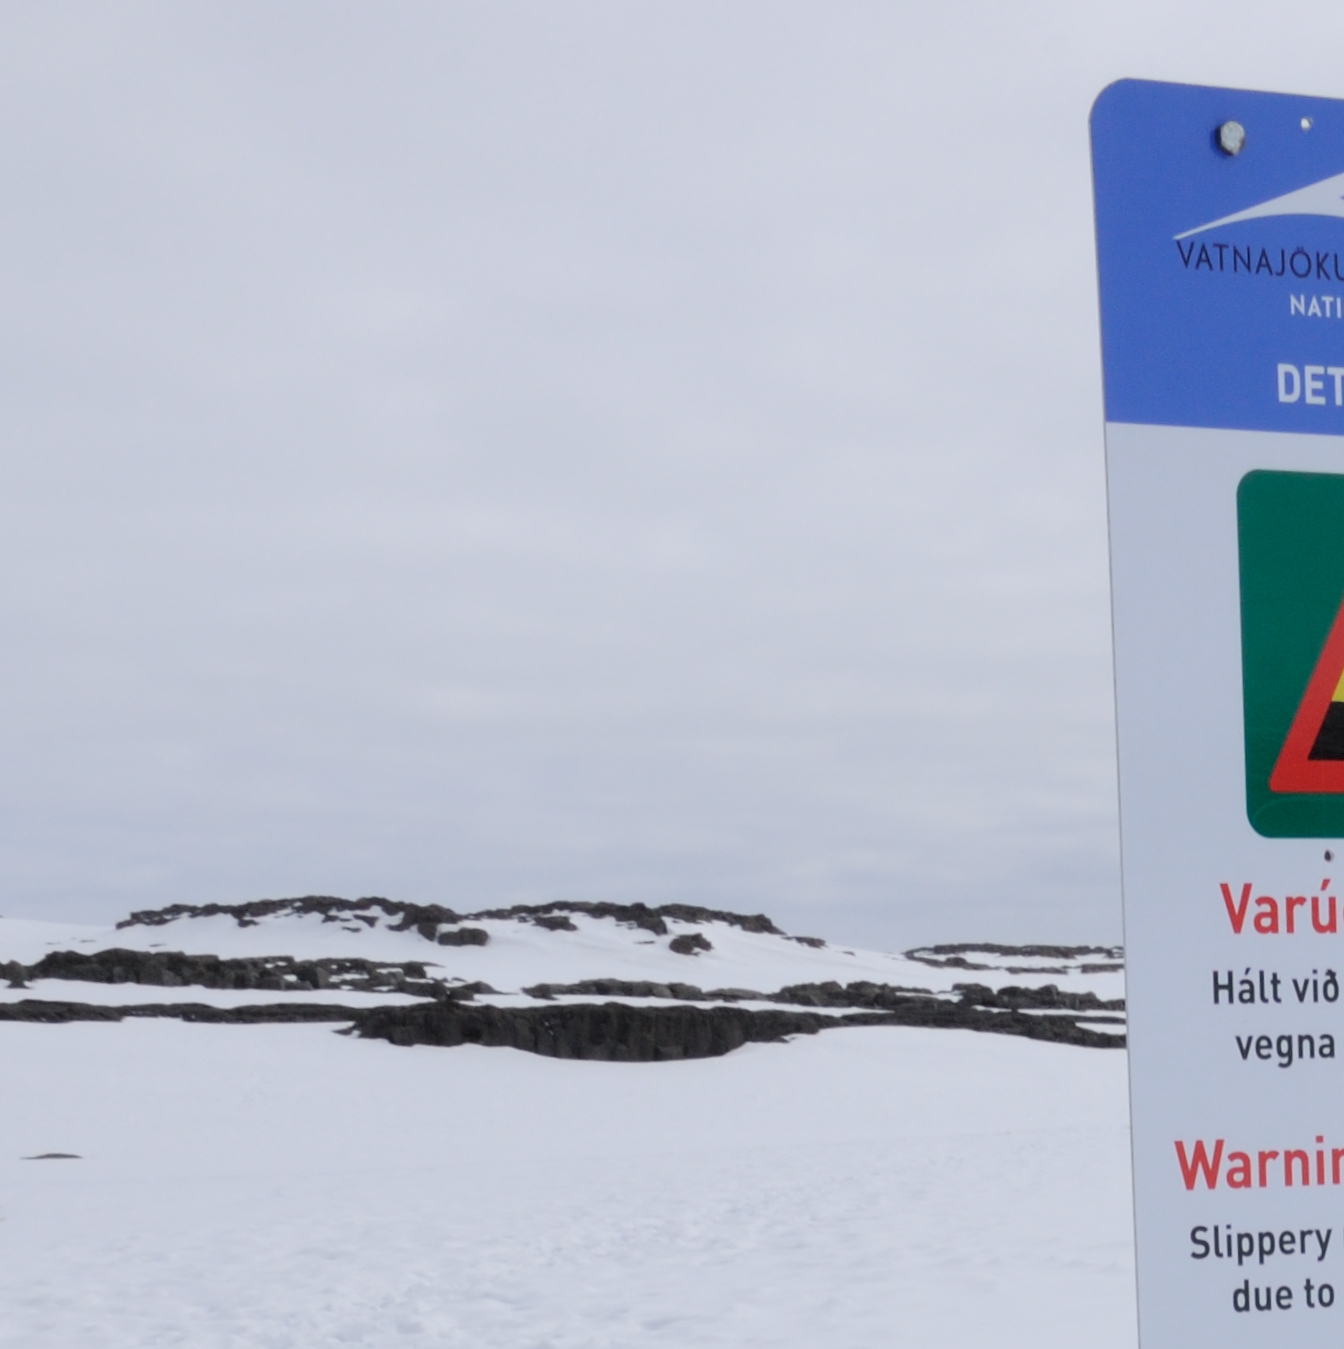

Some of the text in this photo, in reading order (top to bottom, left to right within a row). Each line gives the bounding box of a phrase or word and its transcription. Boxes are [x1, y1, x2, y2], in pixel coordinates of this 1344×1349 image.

[1212, 967, 1281, 1004] Hált
[1292, 969, 1340, 1003] við
[1235, 1030, 1336, 1068] vegna
[1189, 1222, 1332, 1266] Slippery
[1232, 1279, 1293, 1313] due
[1303, 1278, 1335, 1308] to
